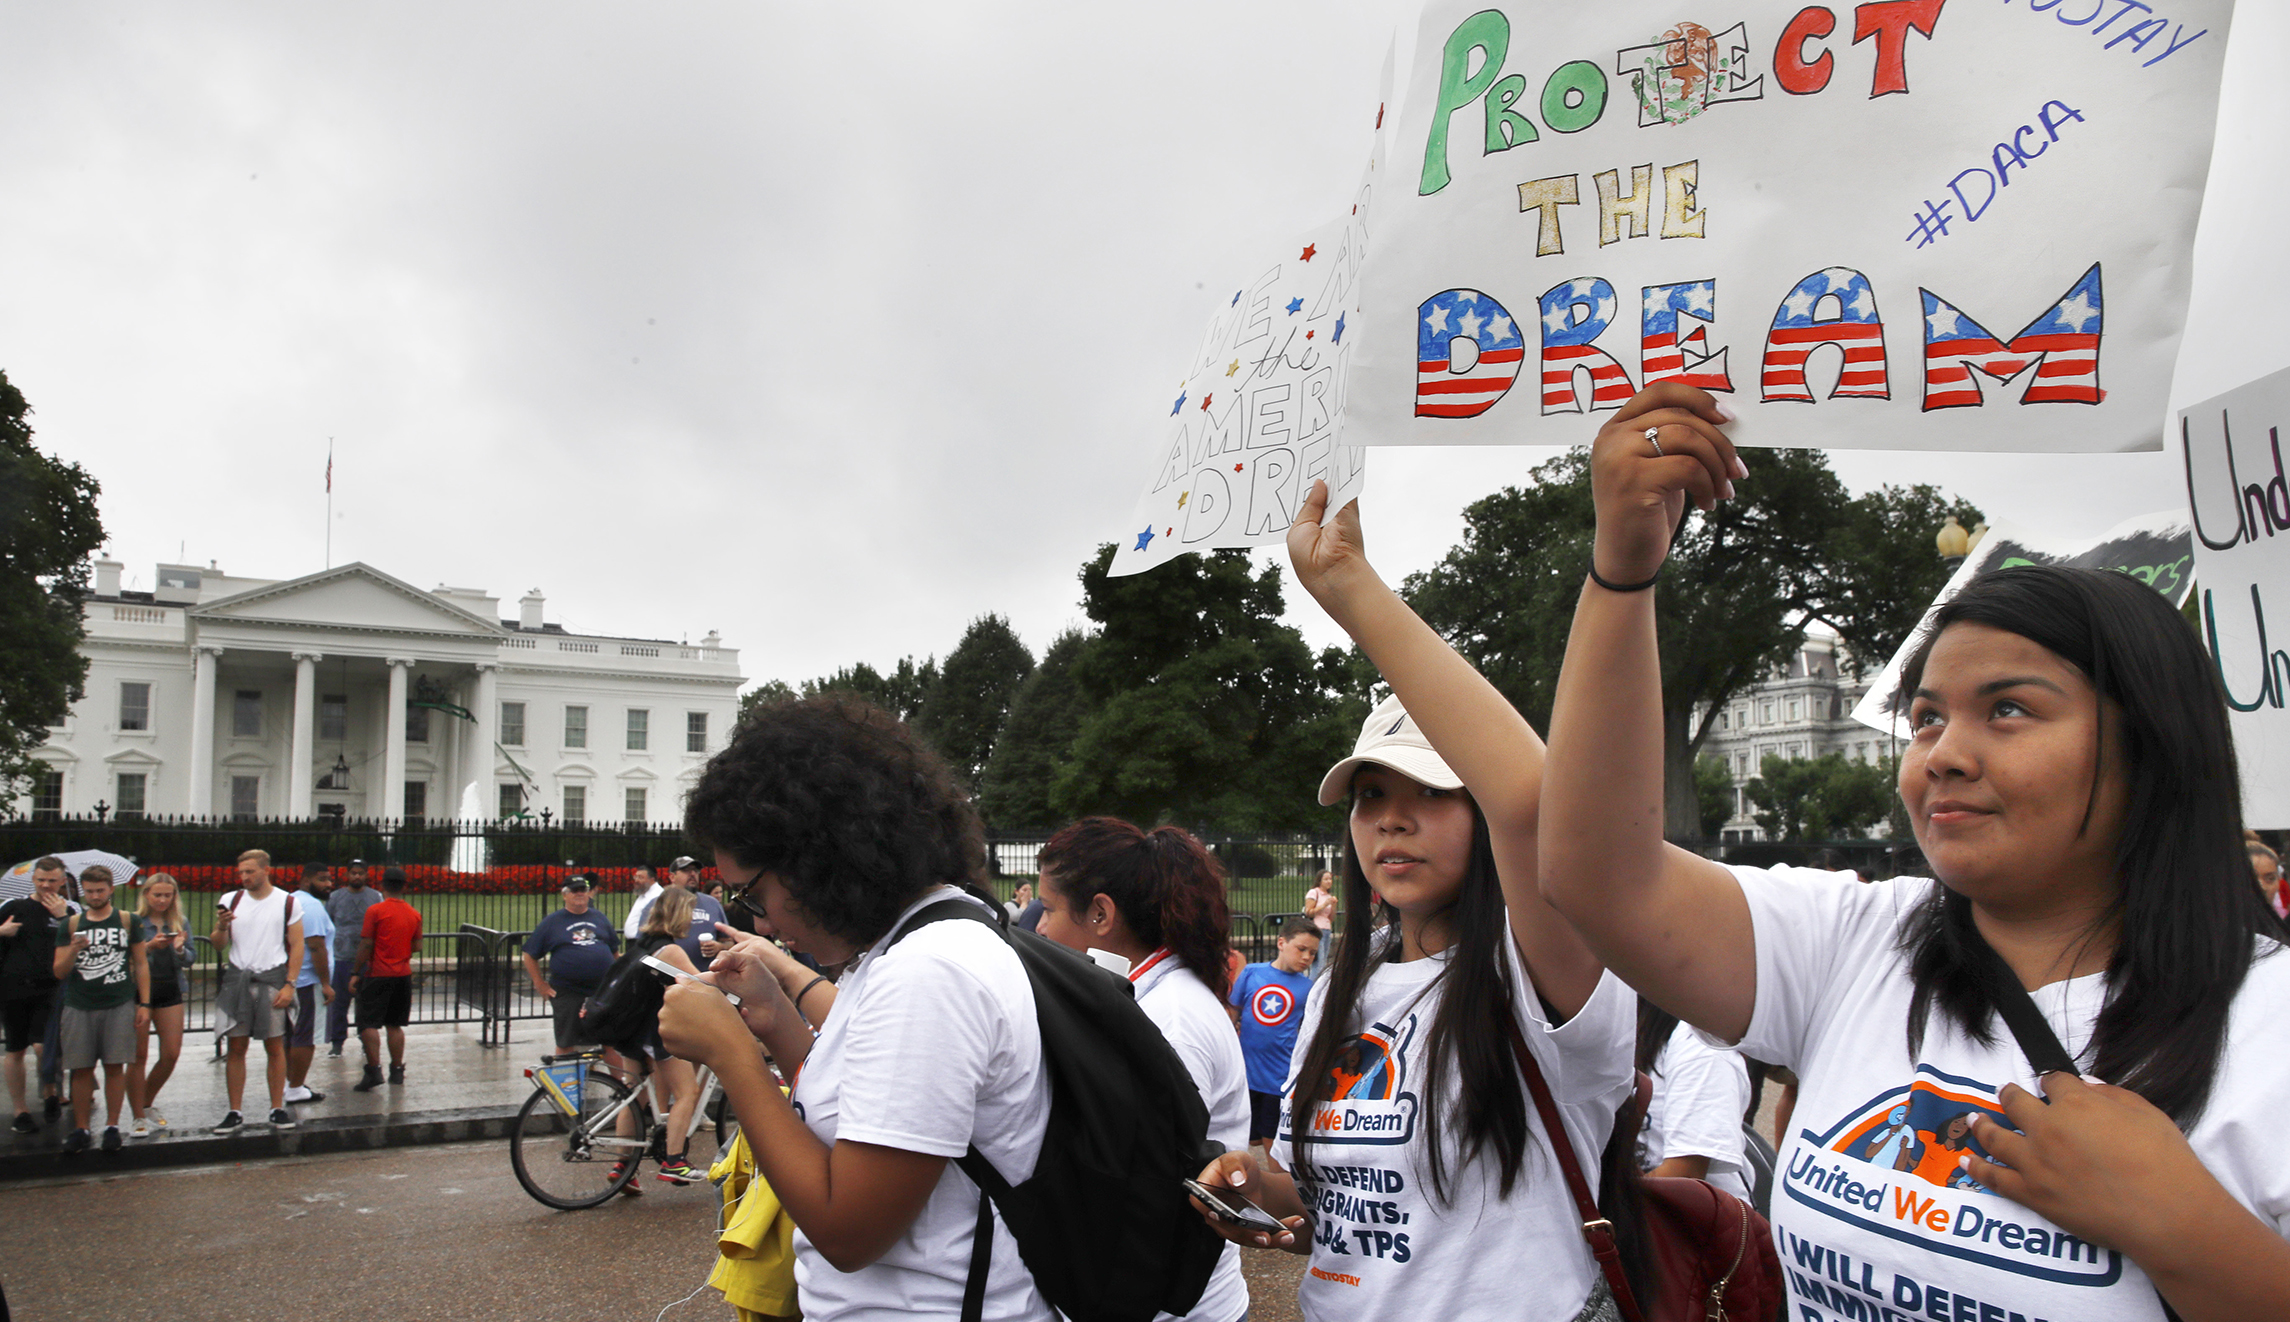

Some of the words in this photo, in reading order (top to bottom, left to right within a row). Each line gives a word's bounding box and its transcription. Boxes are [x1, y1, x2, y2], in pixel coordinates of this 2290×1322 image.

[1418, 0, 1947, 196] PROTECT
[1517, 159, 1708, 257] THE
[1905, 98, 2086, 249] #DACA
[1189, 263, 1282, 382] WE
[1307, 184, 1372, 322] AR
[1415, 261, 2108, 418] DREAM
[1152, 341, 1351, 495] AMERI
[1235, 325, 1320, 393] the
[2183, 407, 2290, 551] Und
[1314, 1108, 1342, 1131] We
[1343, 1108, 1403, 1131] Dream
[1320, 1165, 1404, 1194] DEFEND
[1789, 1146, 1888, 1213] United
[1894, 1185, 1950, 1232] We
[1952, 1204, 2099, 1265] Dream
[1330, 1225, 1352, 1256] &
[1352, 1229, 1412, 1264] TPS
[1778, 1224, 1787, 1255] I
[1788, 1231, 1884, 1301] WILL
